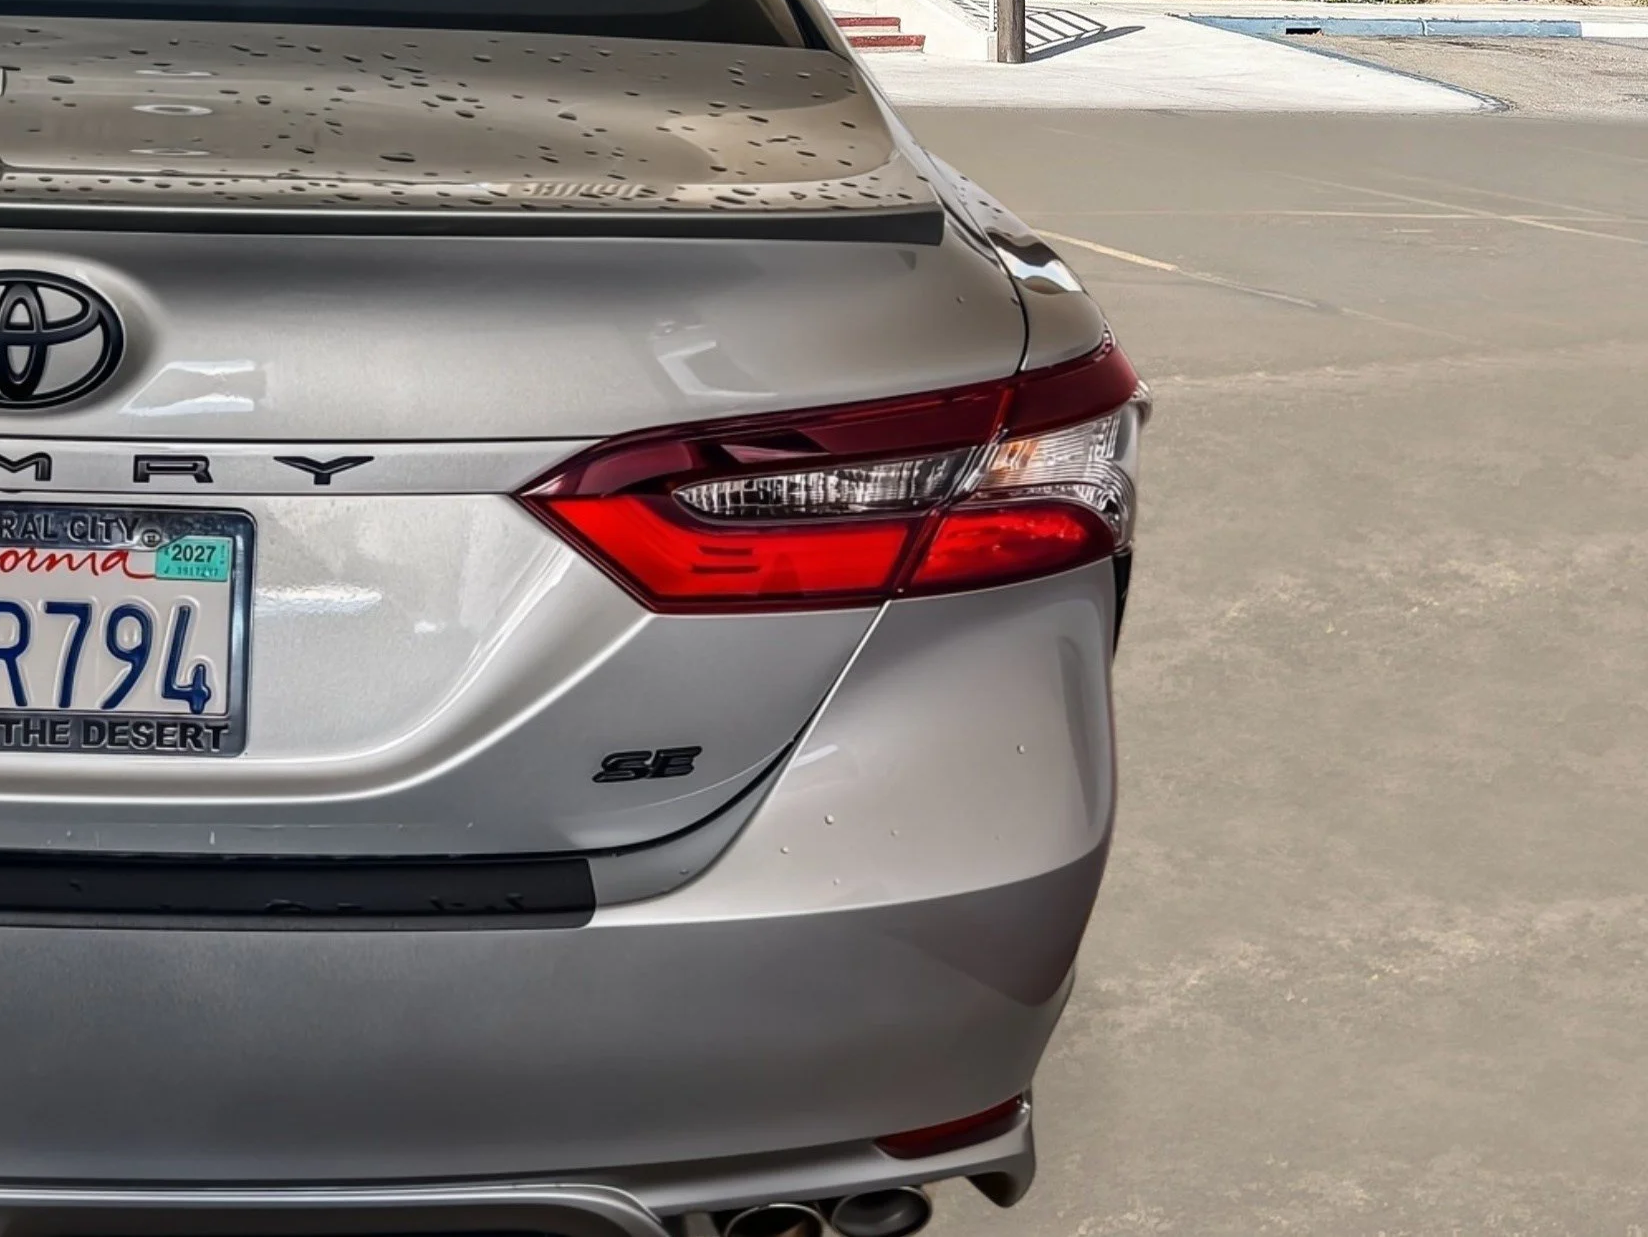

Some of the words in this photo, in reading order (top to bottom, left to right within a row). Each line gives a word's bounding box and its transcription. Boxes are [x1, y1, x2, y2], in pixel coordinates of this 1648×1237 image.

[69, 519, 139, 543] CITY
[171, 543, 217, 563] 2027
[82, 721, 230, 752] DESERT
[592, 746, 702, 783] SE
